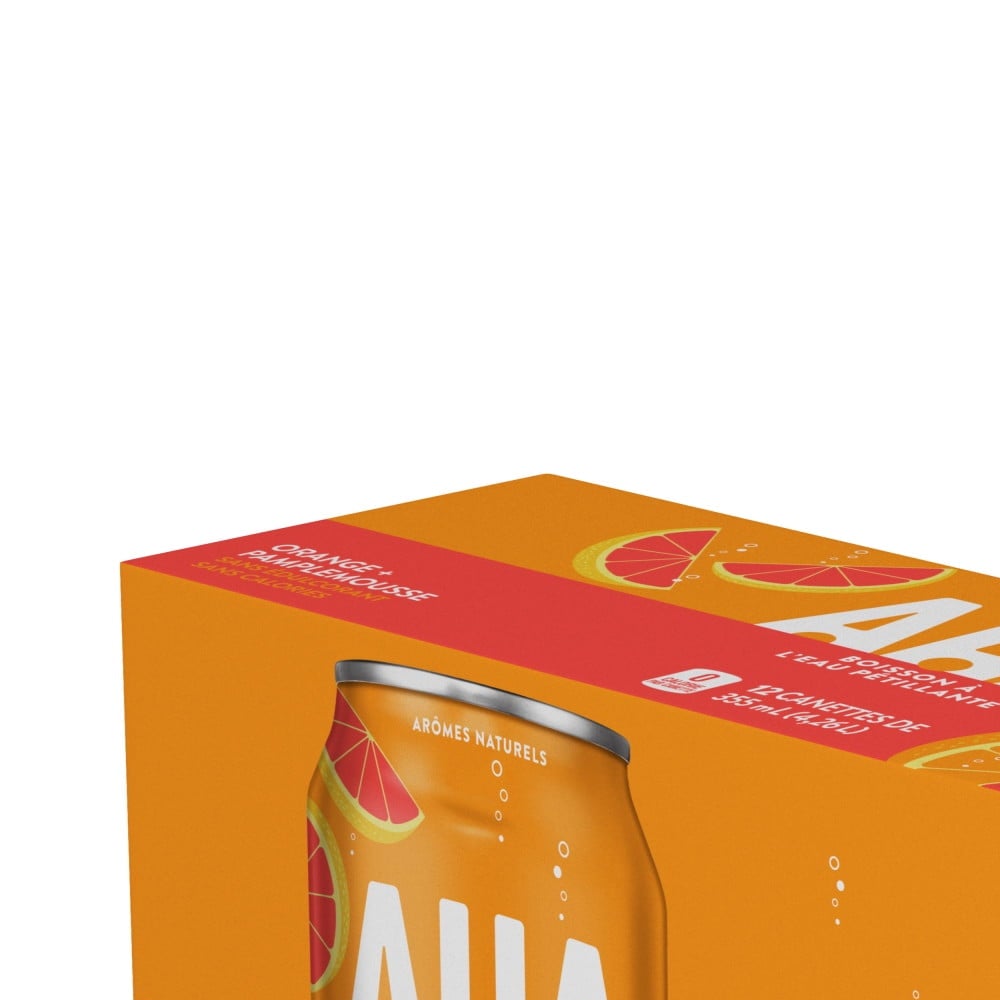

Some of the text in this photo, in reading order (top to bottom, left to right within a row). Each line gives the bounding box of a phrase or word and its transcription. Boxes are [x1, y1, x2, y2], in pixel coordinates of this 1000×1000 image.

[215, 556, 269, 571] SANS
[271, 544, 383, 573] ORANGE
[191, 561, 333, 599] SANS CALORIES
[237, 550, 439, 602] PAMPLEMOUSSE
[688, 673, 721, 682] 0
[775, 651, 850, 671] L'EAU
[839, 655, 983, 694] BOISSON À
[711, 692, 762, 707] 355
[748, 703, 792, 716] mL
[747, 684, 931, 733] 12 CANETTES DE
[412, 716, 547, 766] ARÔMES NATURELS
